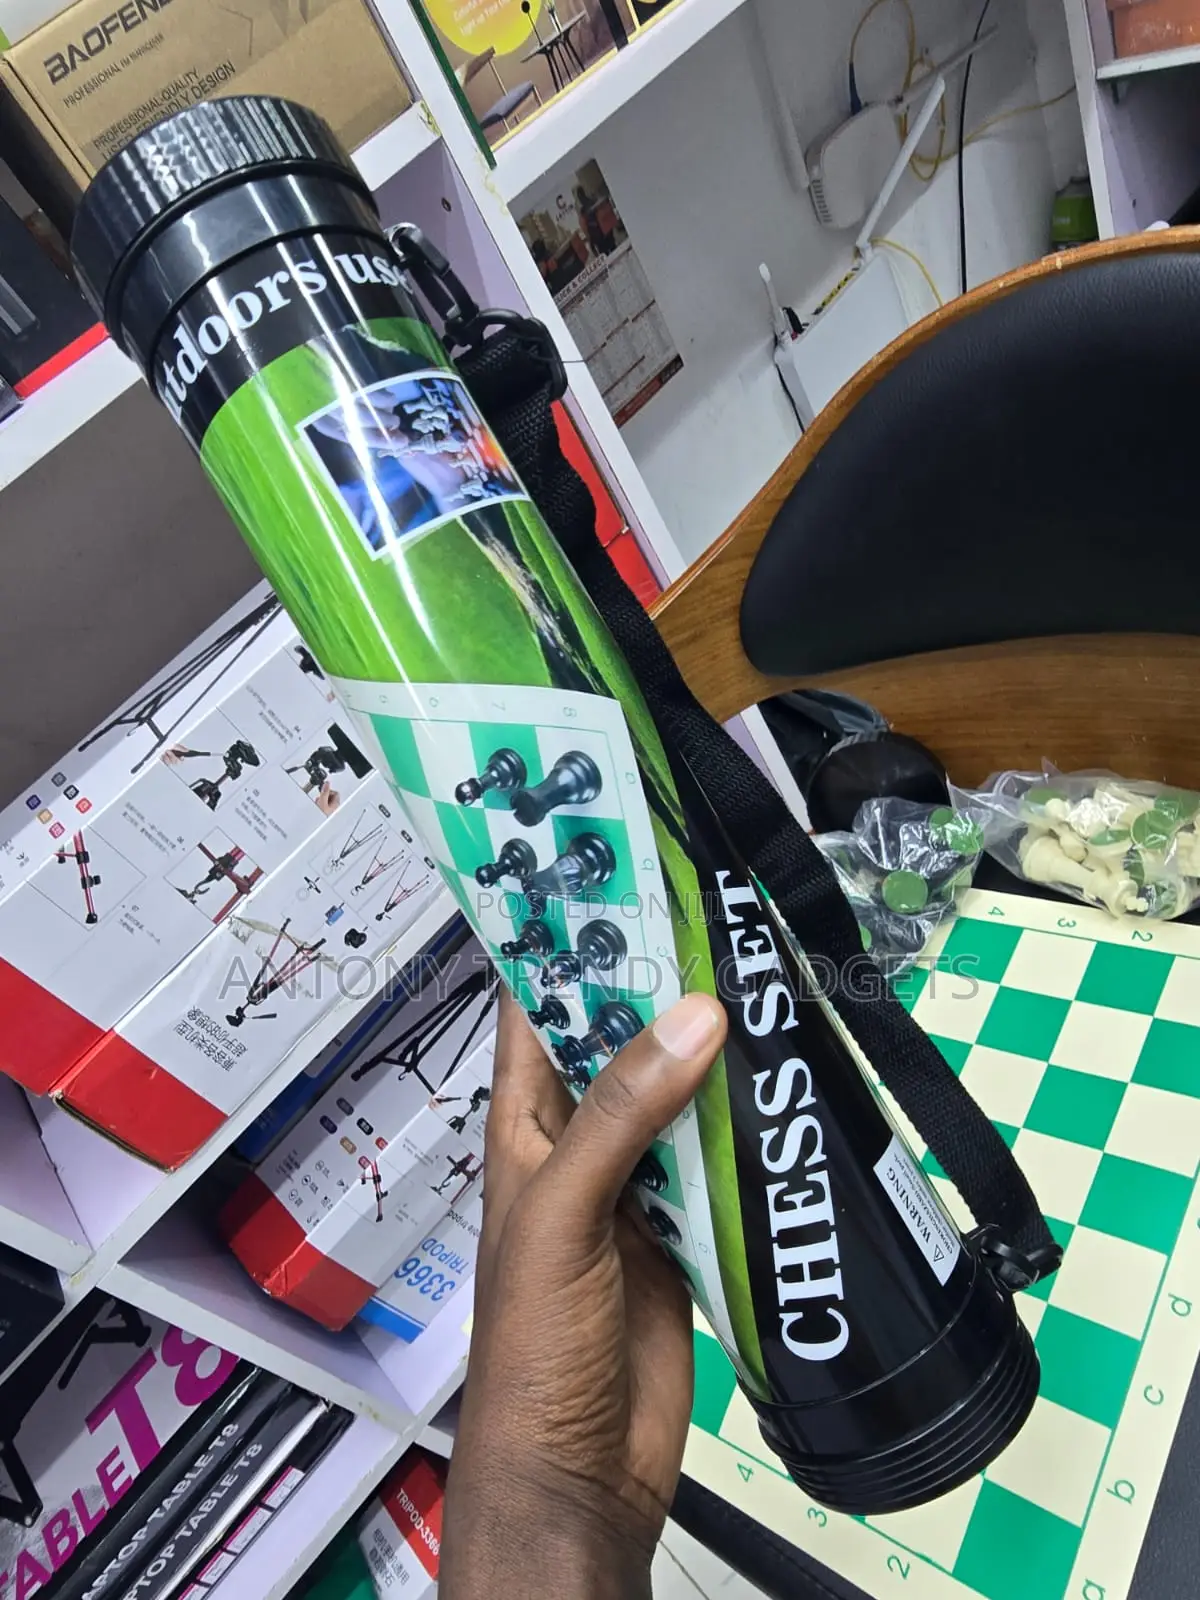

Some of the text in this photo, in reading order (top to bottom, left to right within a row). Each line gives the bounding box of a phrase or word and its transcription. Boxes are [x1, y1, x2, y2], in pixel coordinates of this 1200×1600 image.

[43, 0, 175, 86] BAOFEN
[190, 60, 236, 100] DESIGN
[63, 63, 121, 109] PROFESSIONAL
[987, 905, 1153, 943] 4 3 2
[187, 1005, 248, 1058] 超乎你的想象
[715, 869, 850, 1362] CHESS SET
[886, 1167, 932, 1244] WARNING
[394, 1257, 456, 1301] 3366
[421, 1238, 469, 1275] TRIPOD
[1106, 1479, 1136, 1504] b
[1143, 1384, 1164, 1405] c
[1168, 1292, 1192, 1317] d
[147, 1453, 215, 1524] TABLE
[208, 1423, 239, 1452] T8
[174, 1473, 239, 1542] TABLE
[233, 1443, 263, 1471] T8
[0, 1445, 134, 1600] ABLE
[736, 1462, 911, 1580] 4 3 2
